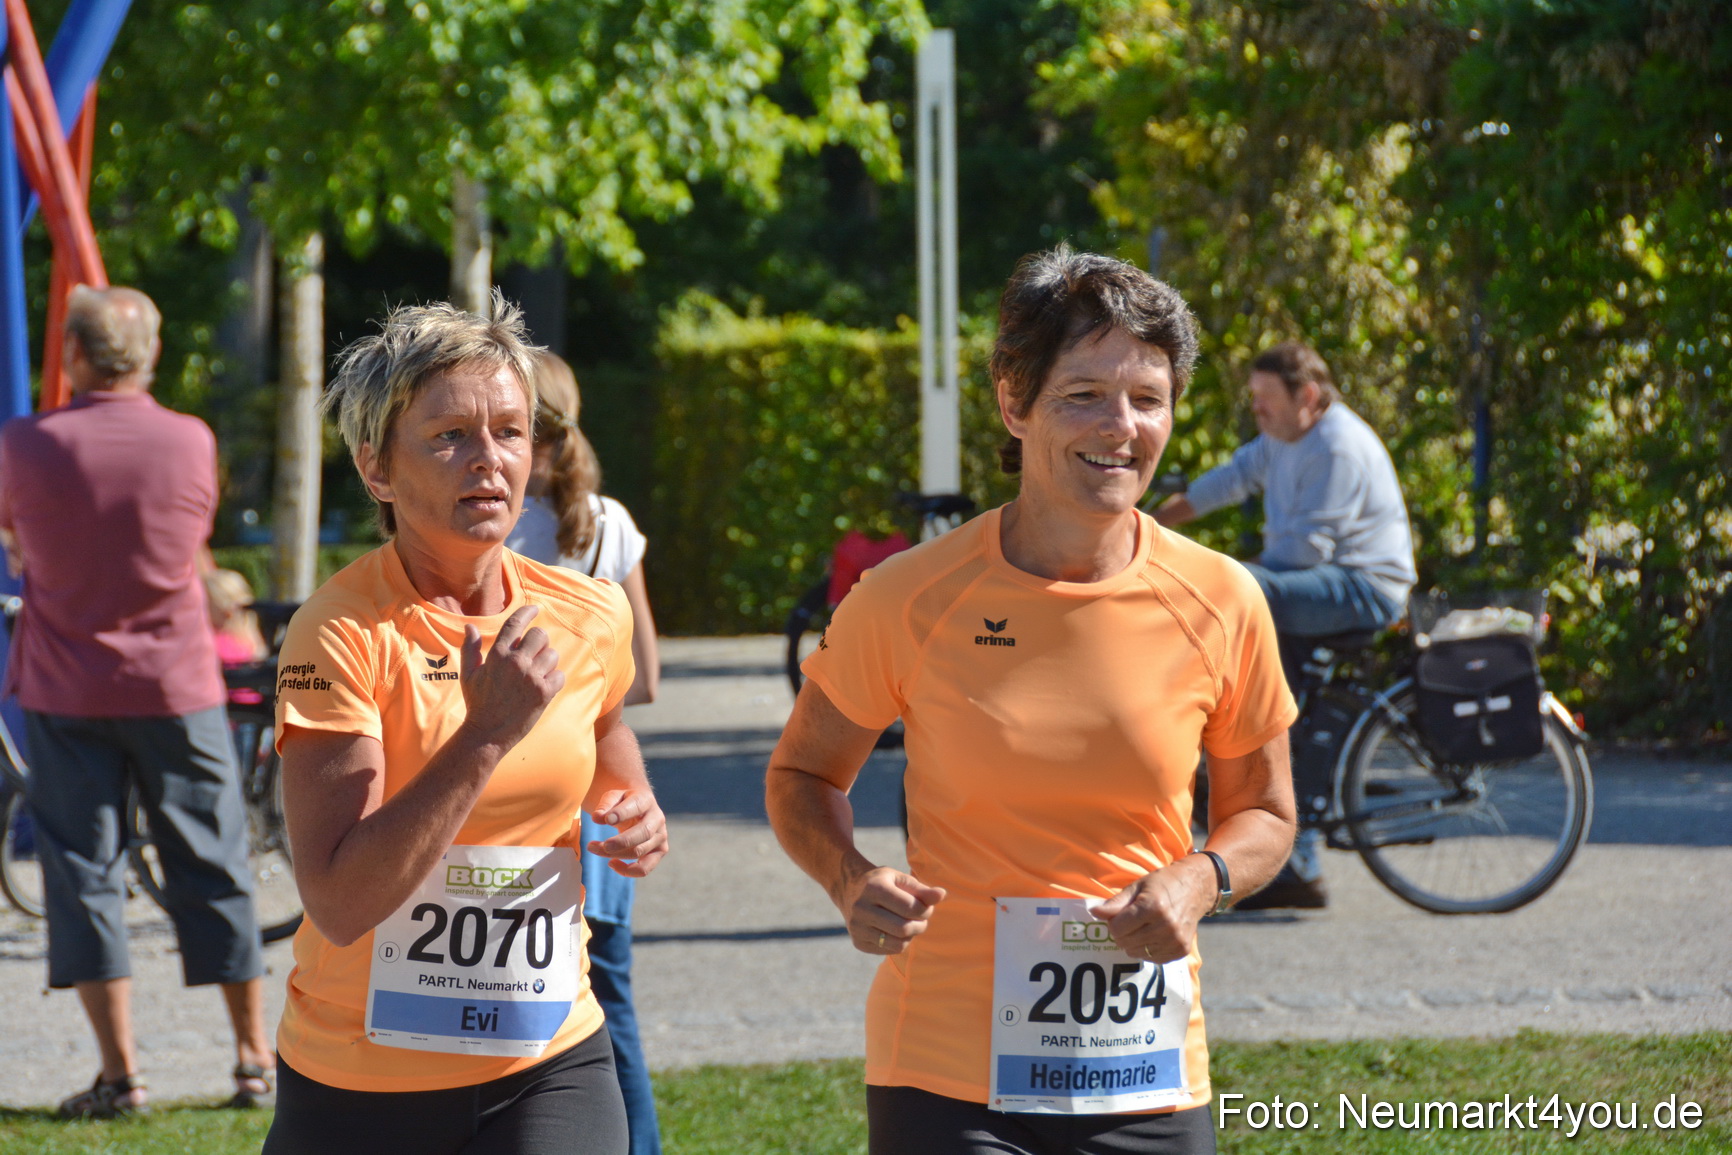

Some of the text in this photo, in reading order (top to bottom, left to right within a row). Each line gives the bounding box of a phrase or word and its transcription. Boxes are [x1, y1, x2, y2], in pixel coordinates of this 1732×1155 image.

[975, 635, 1016, 647] erima
[420, 671, 459, 681] erima
[279, 677, 333, 692] nsfeld Gbr
[446, 865, 534, 889] BOCK
[445, 887, 476, 896] inspired
[476, 888, 485, 897] by
[406, 902, 554, 970] 2070
[1062, 921, 1117, 943] BO
[385, 947, 393, 958] D
[1061, 943, 1091, 952] inspired
[1092, 944, 1101, 952] by
[418, 974, 529, 992] PARTL Neumarkt
[1027, 961, 1167, 1025] 2054
[460, 1005, 499, 1032] Evi
[1005, 1010, 1014, 1021] D
[1040, 1034, 1142, 1048] PARTL Neumarkt
[1030, 1060, 1156, 1091] Heidemarie
